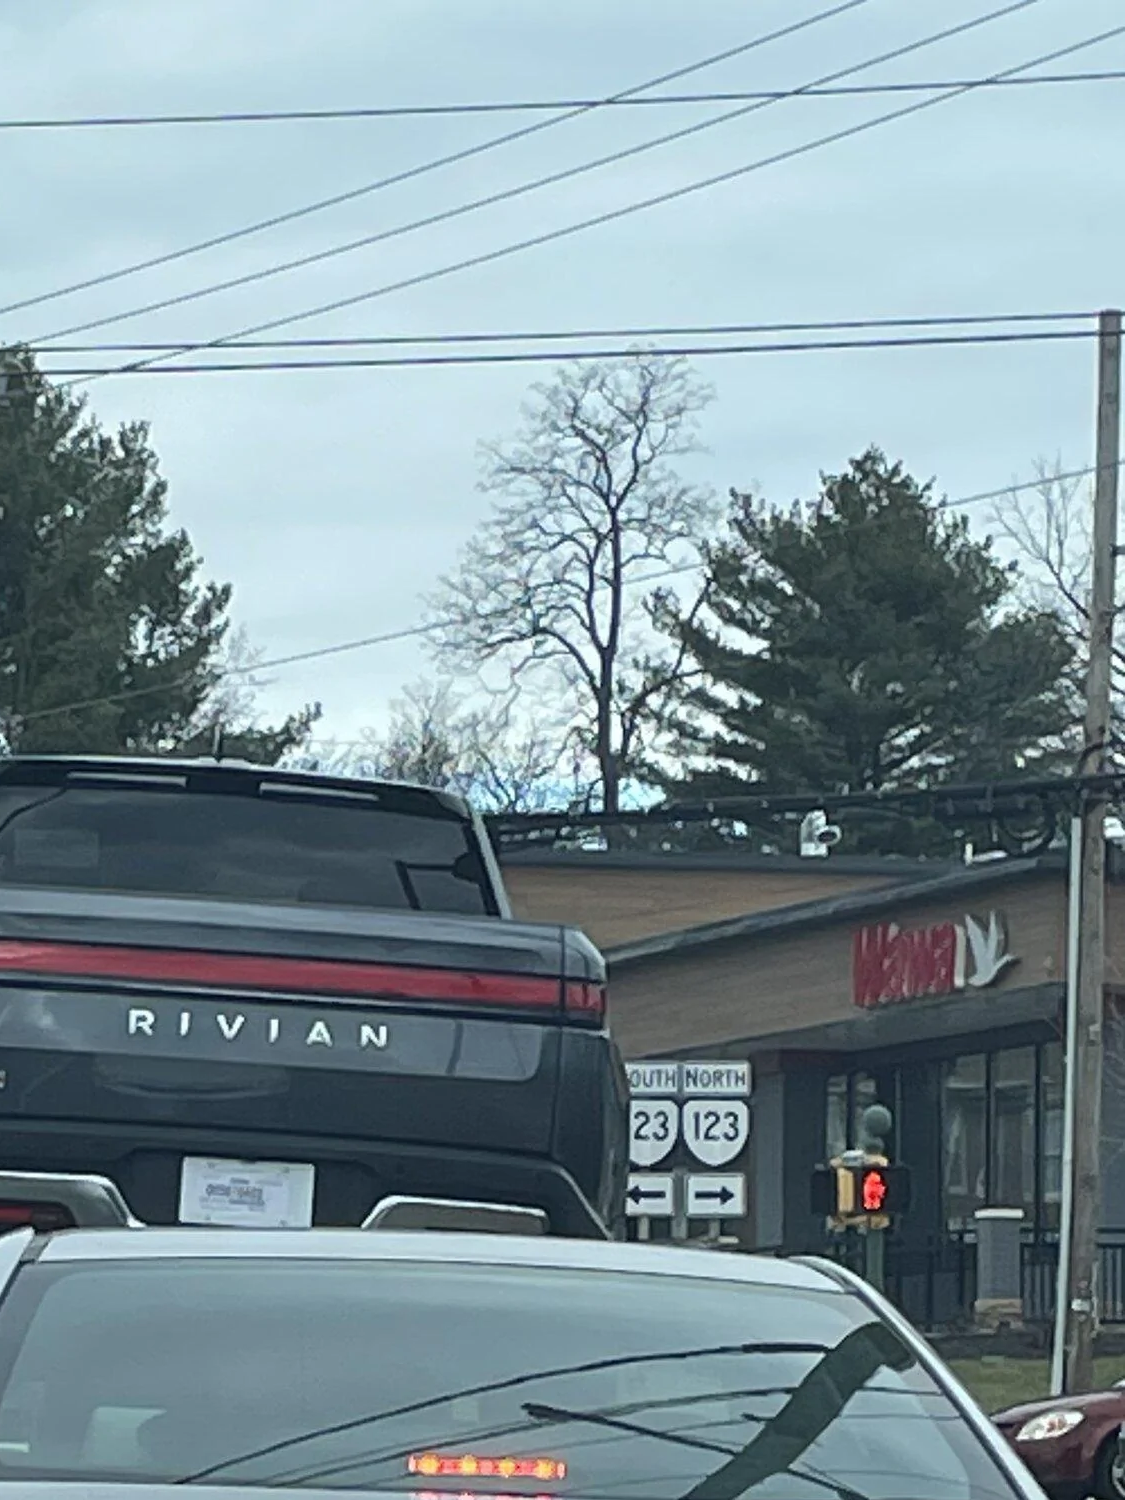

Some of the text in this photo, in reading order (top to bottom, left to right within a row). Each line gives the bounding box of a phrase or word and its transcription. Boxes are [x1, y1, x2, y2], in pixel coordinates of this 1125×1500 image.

[128, 1008, 388, 1048] RIVIAN
[630, 1068, 676, 1088] OUTH
[685, 1067, 746, 1089] NORTH
[633, 1110, 670, 1141] 23
[693, 1110, 740, 1141] 123
